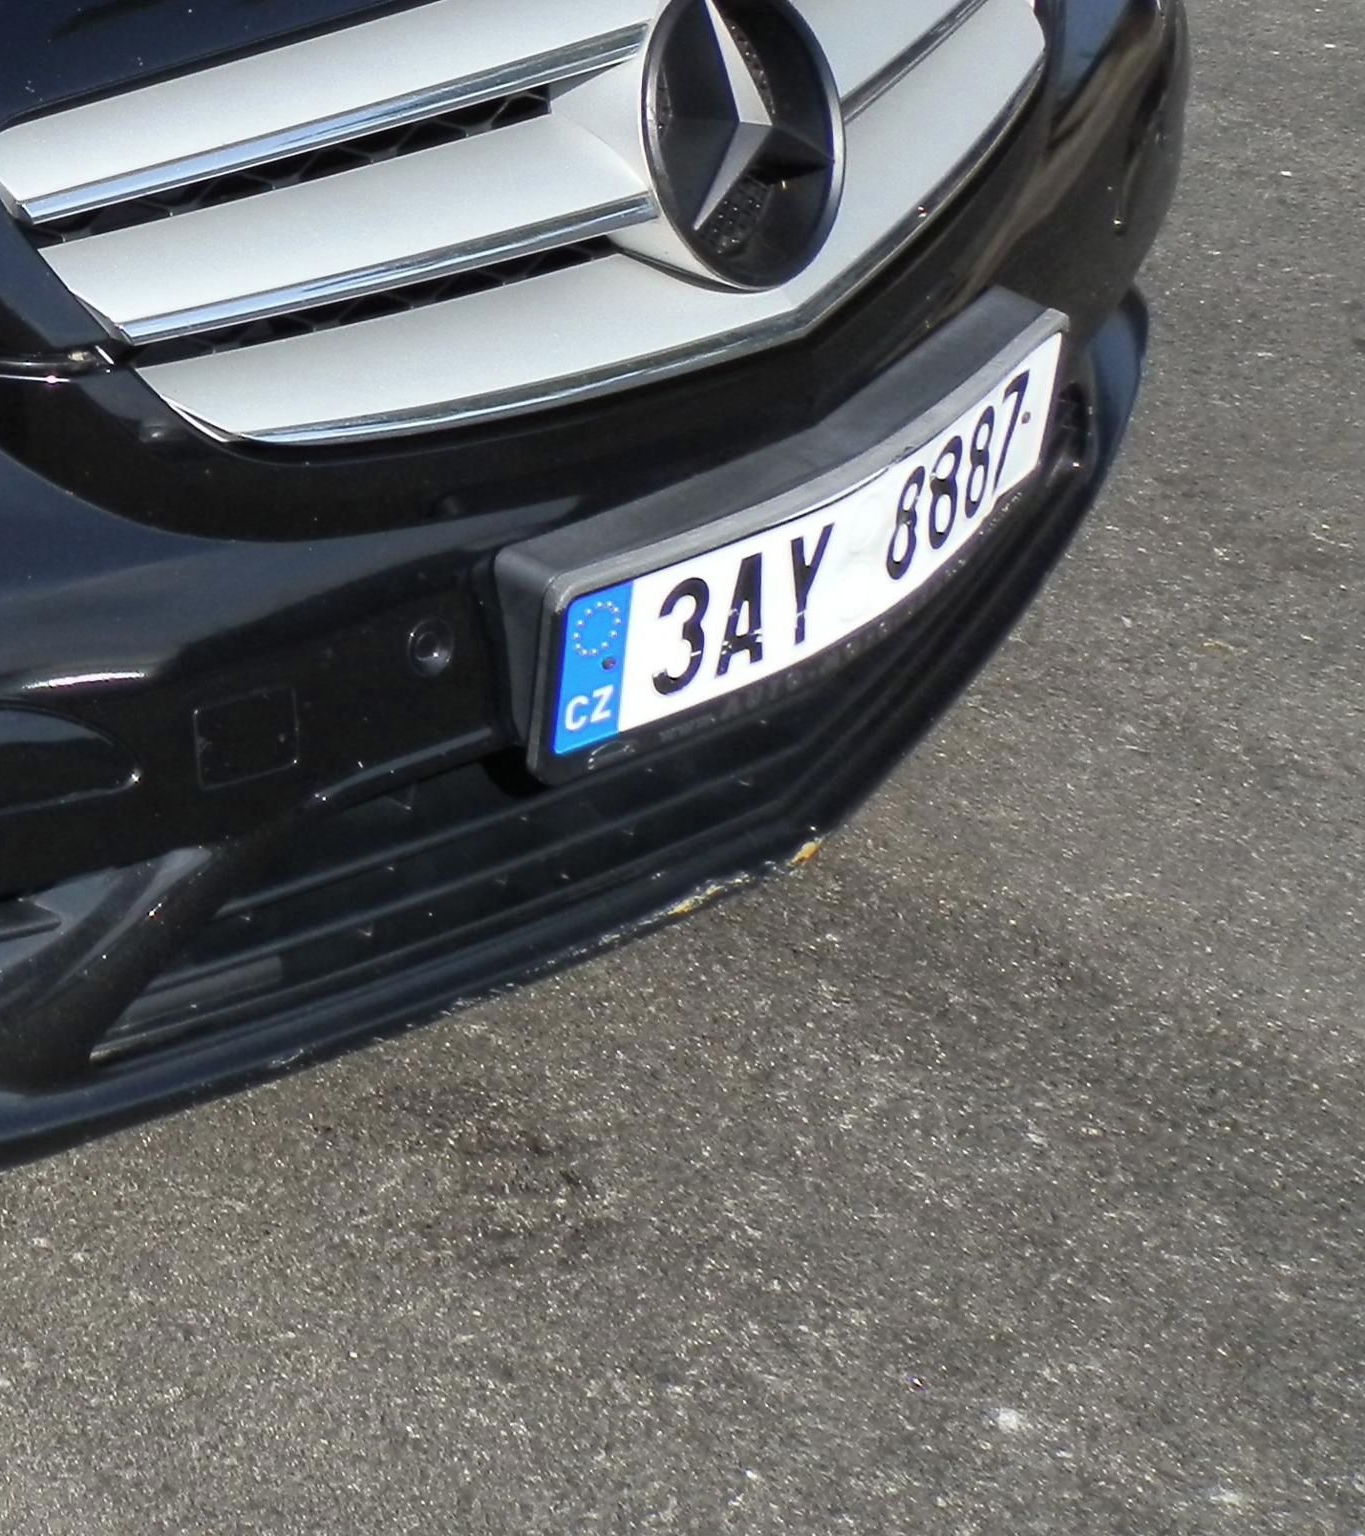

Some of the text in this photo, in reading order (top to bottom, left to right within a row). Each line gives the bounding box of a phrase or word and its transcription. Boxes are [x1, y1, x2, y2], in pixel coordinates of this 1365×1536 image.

[652, 523, 835, 696] 3AY
[886, 370, 1030, 581] 8887
[564, 686, 614, 731] CZ
